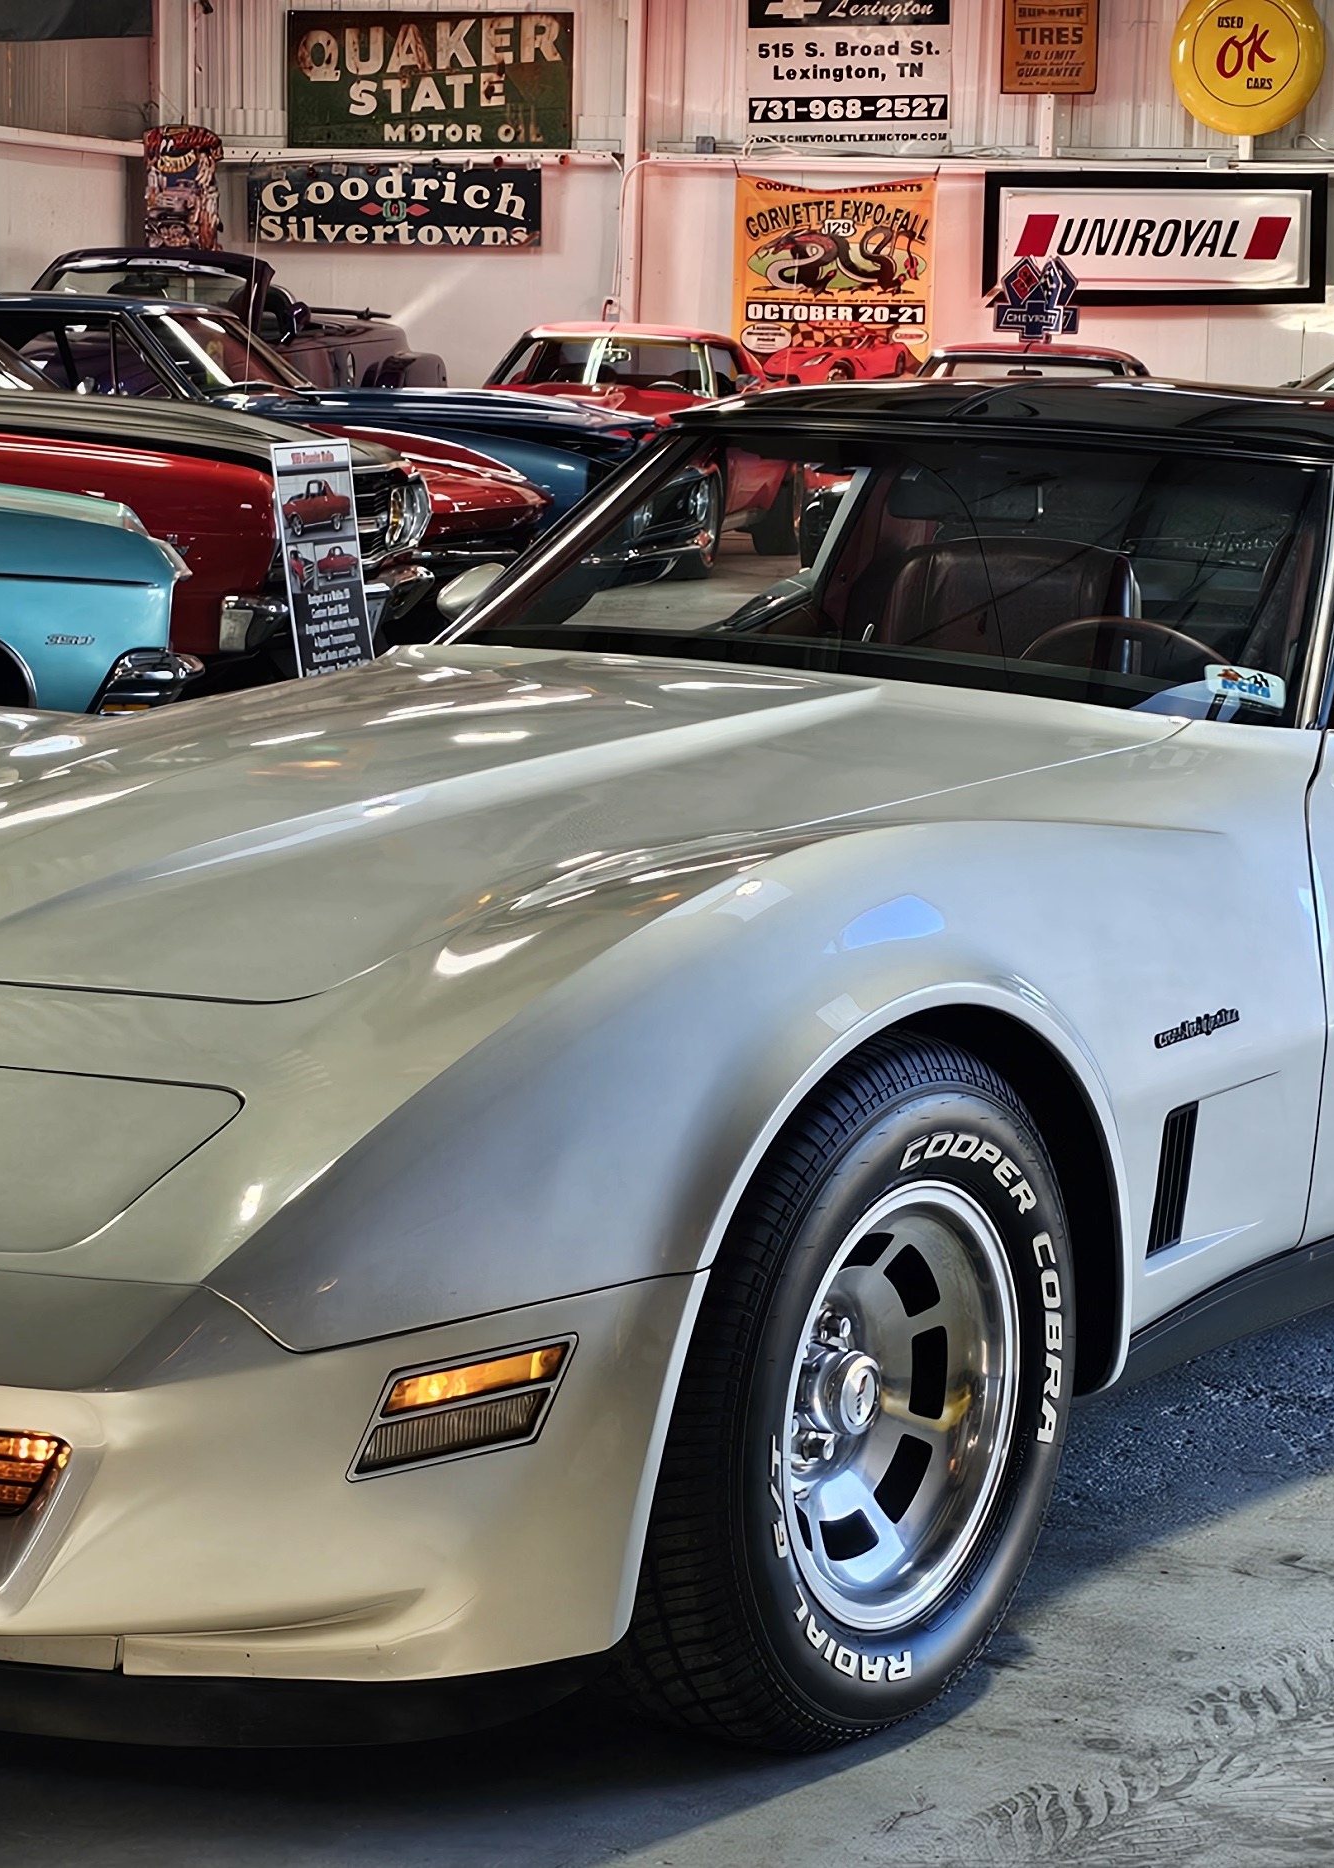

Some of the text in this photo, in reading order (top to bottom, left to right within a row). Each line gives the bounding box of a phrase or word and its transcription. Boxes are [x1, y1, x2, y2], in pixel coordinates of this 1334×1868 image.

[829, 0, 933, 22] Lexington
[1217, 16, 1244, 28] USED
[1016, 27, 1083, 45] TIRES
[297, 14, 562, 82] QUAKER
[758, 40, 940, 58] 515 S. Broad St.
[1024, 50, 1076, 60] NO LIMIT
[1216, 23, 1276, 79] OK
[773, 62, 923, 82] Lexington, TN
[1017, 67, 1081, 78] GUARANTEE
[349, 72, 506, 115] STATE
[1247, 78, 1273, 90] CARS
[752, 97, 945, 120] 731-968-2527
[384, 123, 482, 143] MOTOR
[261, 167, 526, 220] Goodrich
[860, 183, 923, 194] PRESENTS
[261, 215, 530, 245] Silvertowns
[746, 200, 835, 238] CORVETTE
[841, 200, 885, 225] EXPO
[1056, 217, 1240, 258] UNIROYAL
[747, 304, 924, 323] OCTOBER 20-21
[899, 1131, 1038, 1215] COOPER
[1032, 1232, 1067, 1444] COBRA
[794, 1582, 913, 1683] RADIAL
